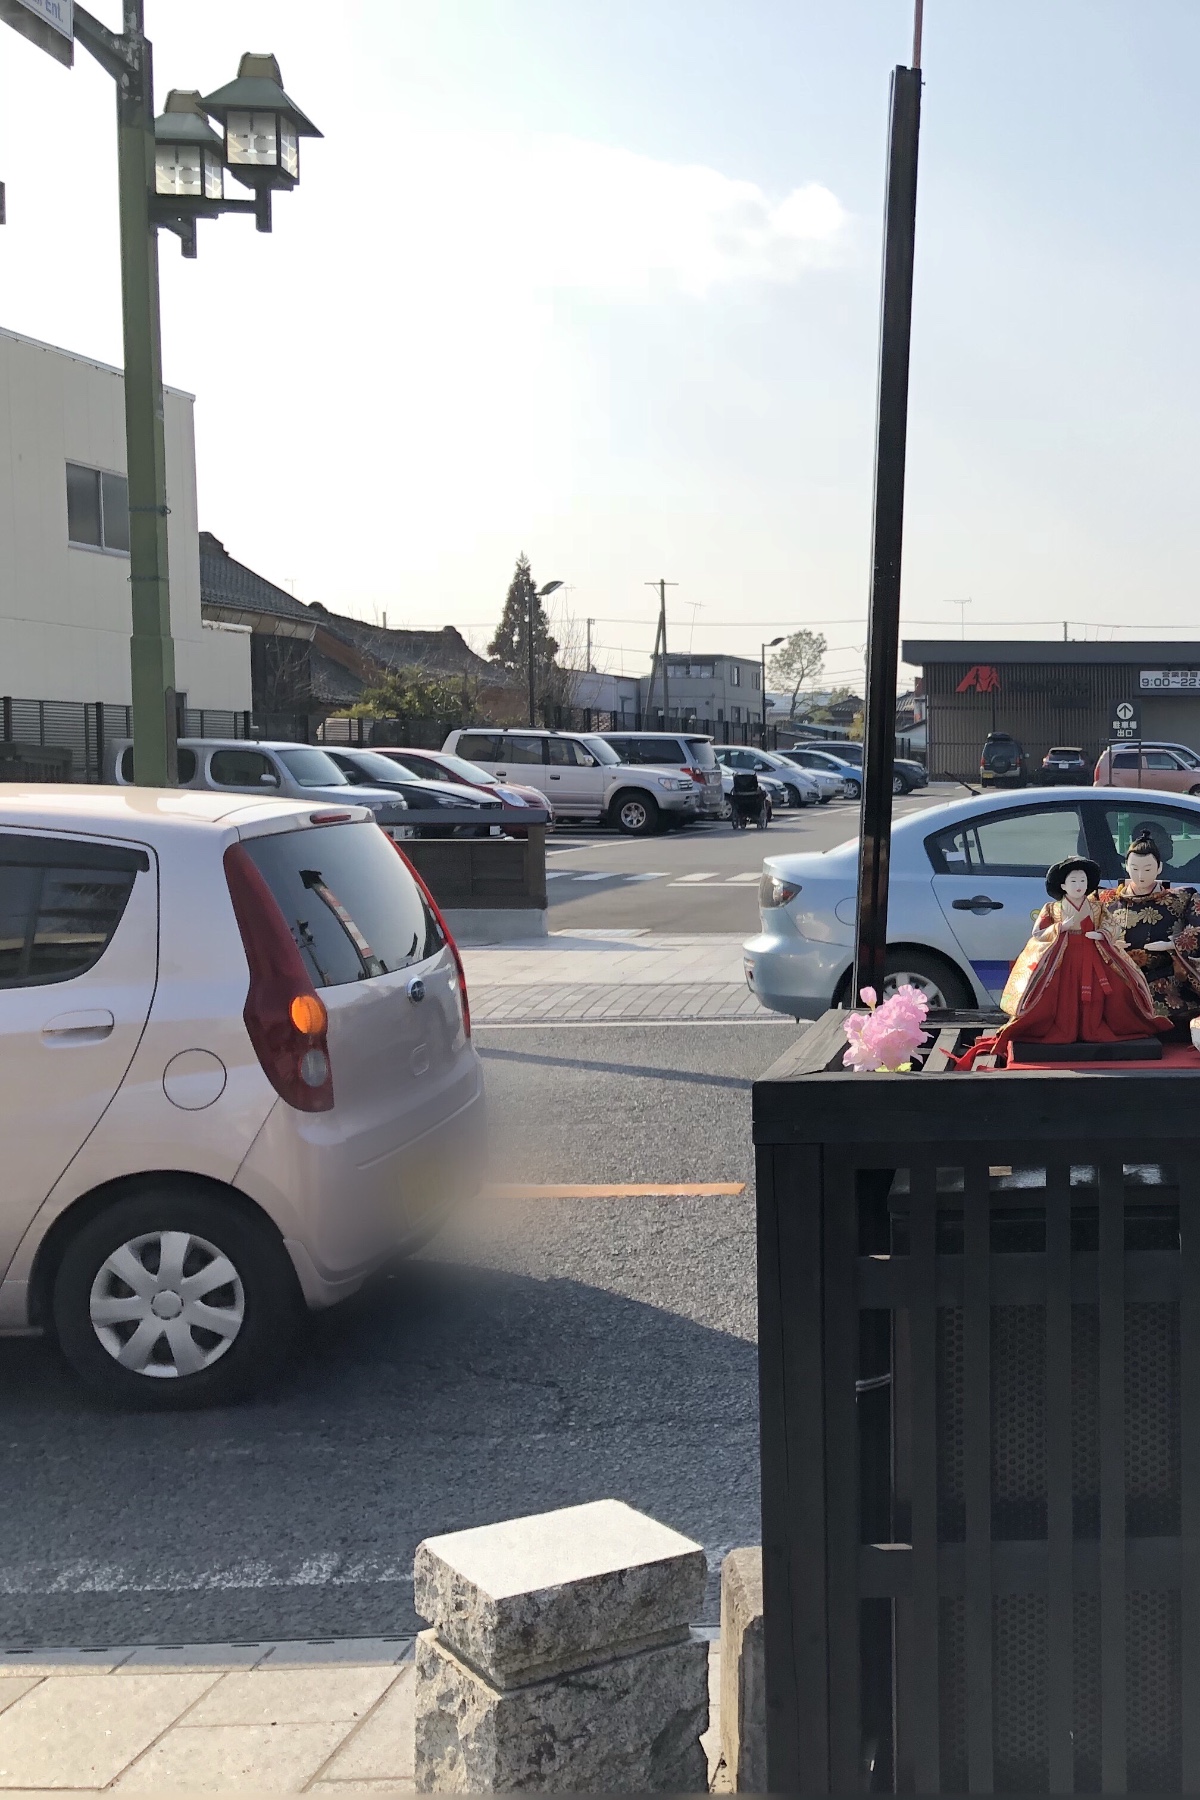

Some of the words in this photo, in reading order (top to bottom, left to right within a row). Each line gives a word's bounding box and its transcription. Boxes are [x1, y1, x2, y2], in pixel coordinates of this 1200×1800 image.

[1112, 720, 1137, 730] 駐車場
[1116, 729, 1133, 737] 出口
